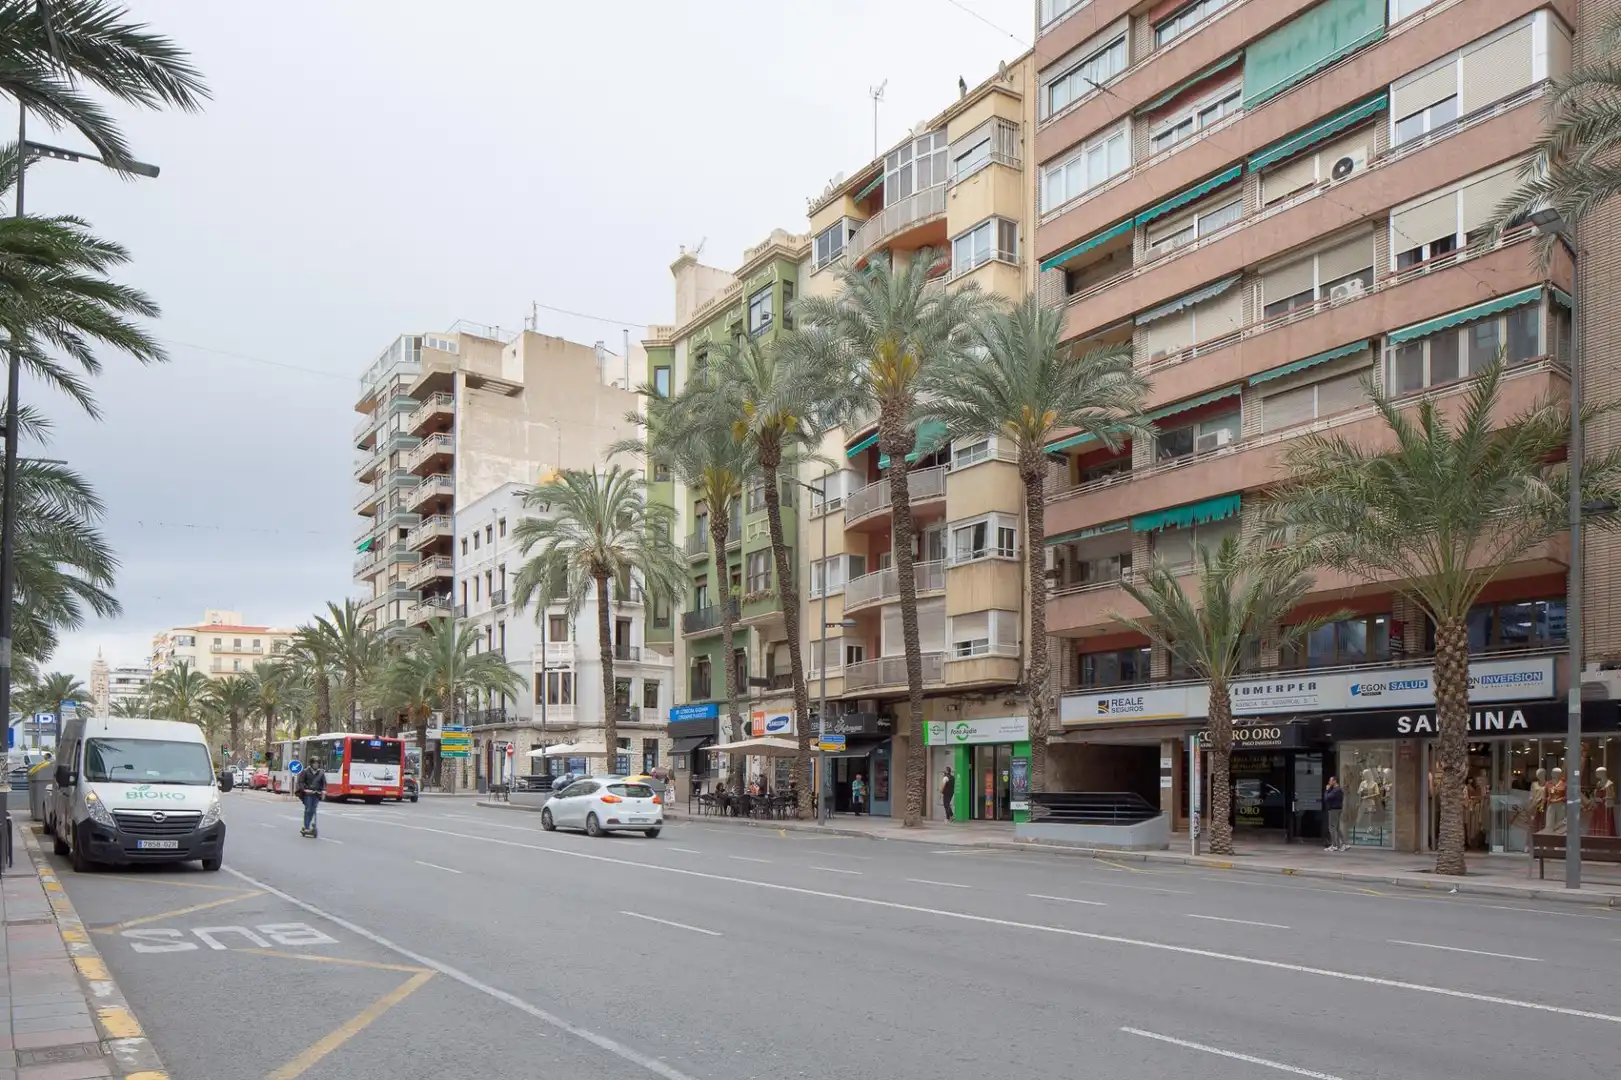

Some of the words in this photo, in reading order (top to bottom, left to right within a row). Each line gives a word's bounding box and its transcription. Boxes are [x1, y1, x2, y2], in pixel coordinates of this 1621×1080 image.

[1482, 671, 1542, 684] INVERSION
[1390, 680, 1427, 690] SALUD
[1111, 697, 1144, 707] REALE
[1111, 705, 1144, 714] SEGUROS
[1397, 710, 1528, 734] SAINA
[1198, 729, 1249, 743] CORO
[1252, 728, 1281, 740] ORO
[126, 791, 186, 801] BIOKO
[120, 922, 340, 954] BUS
